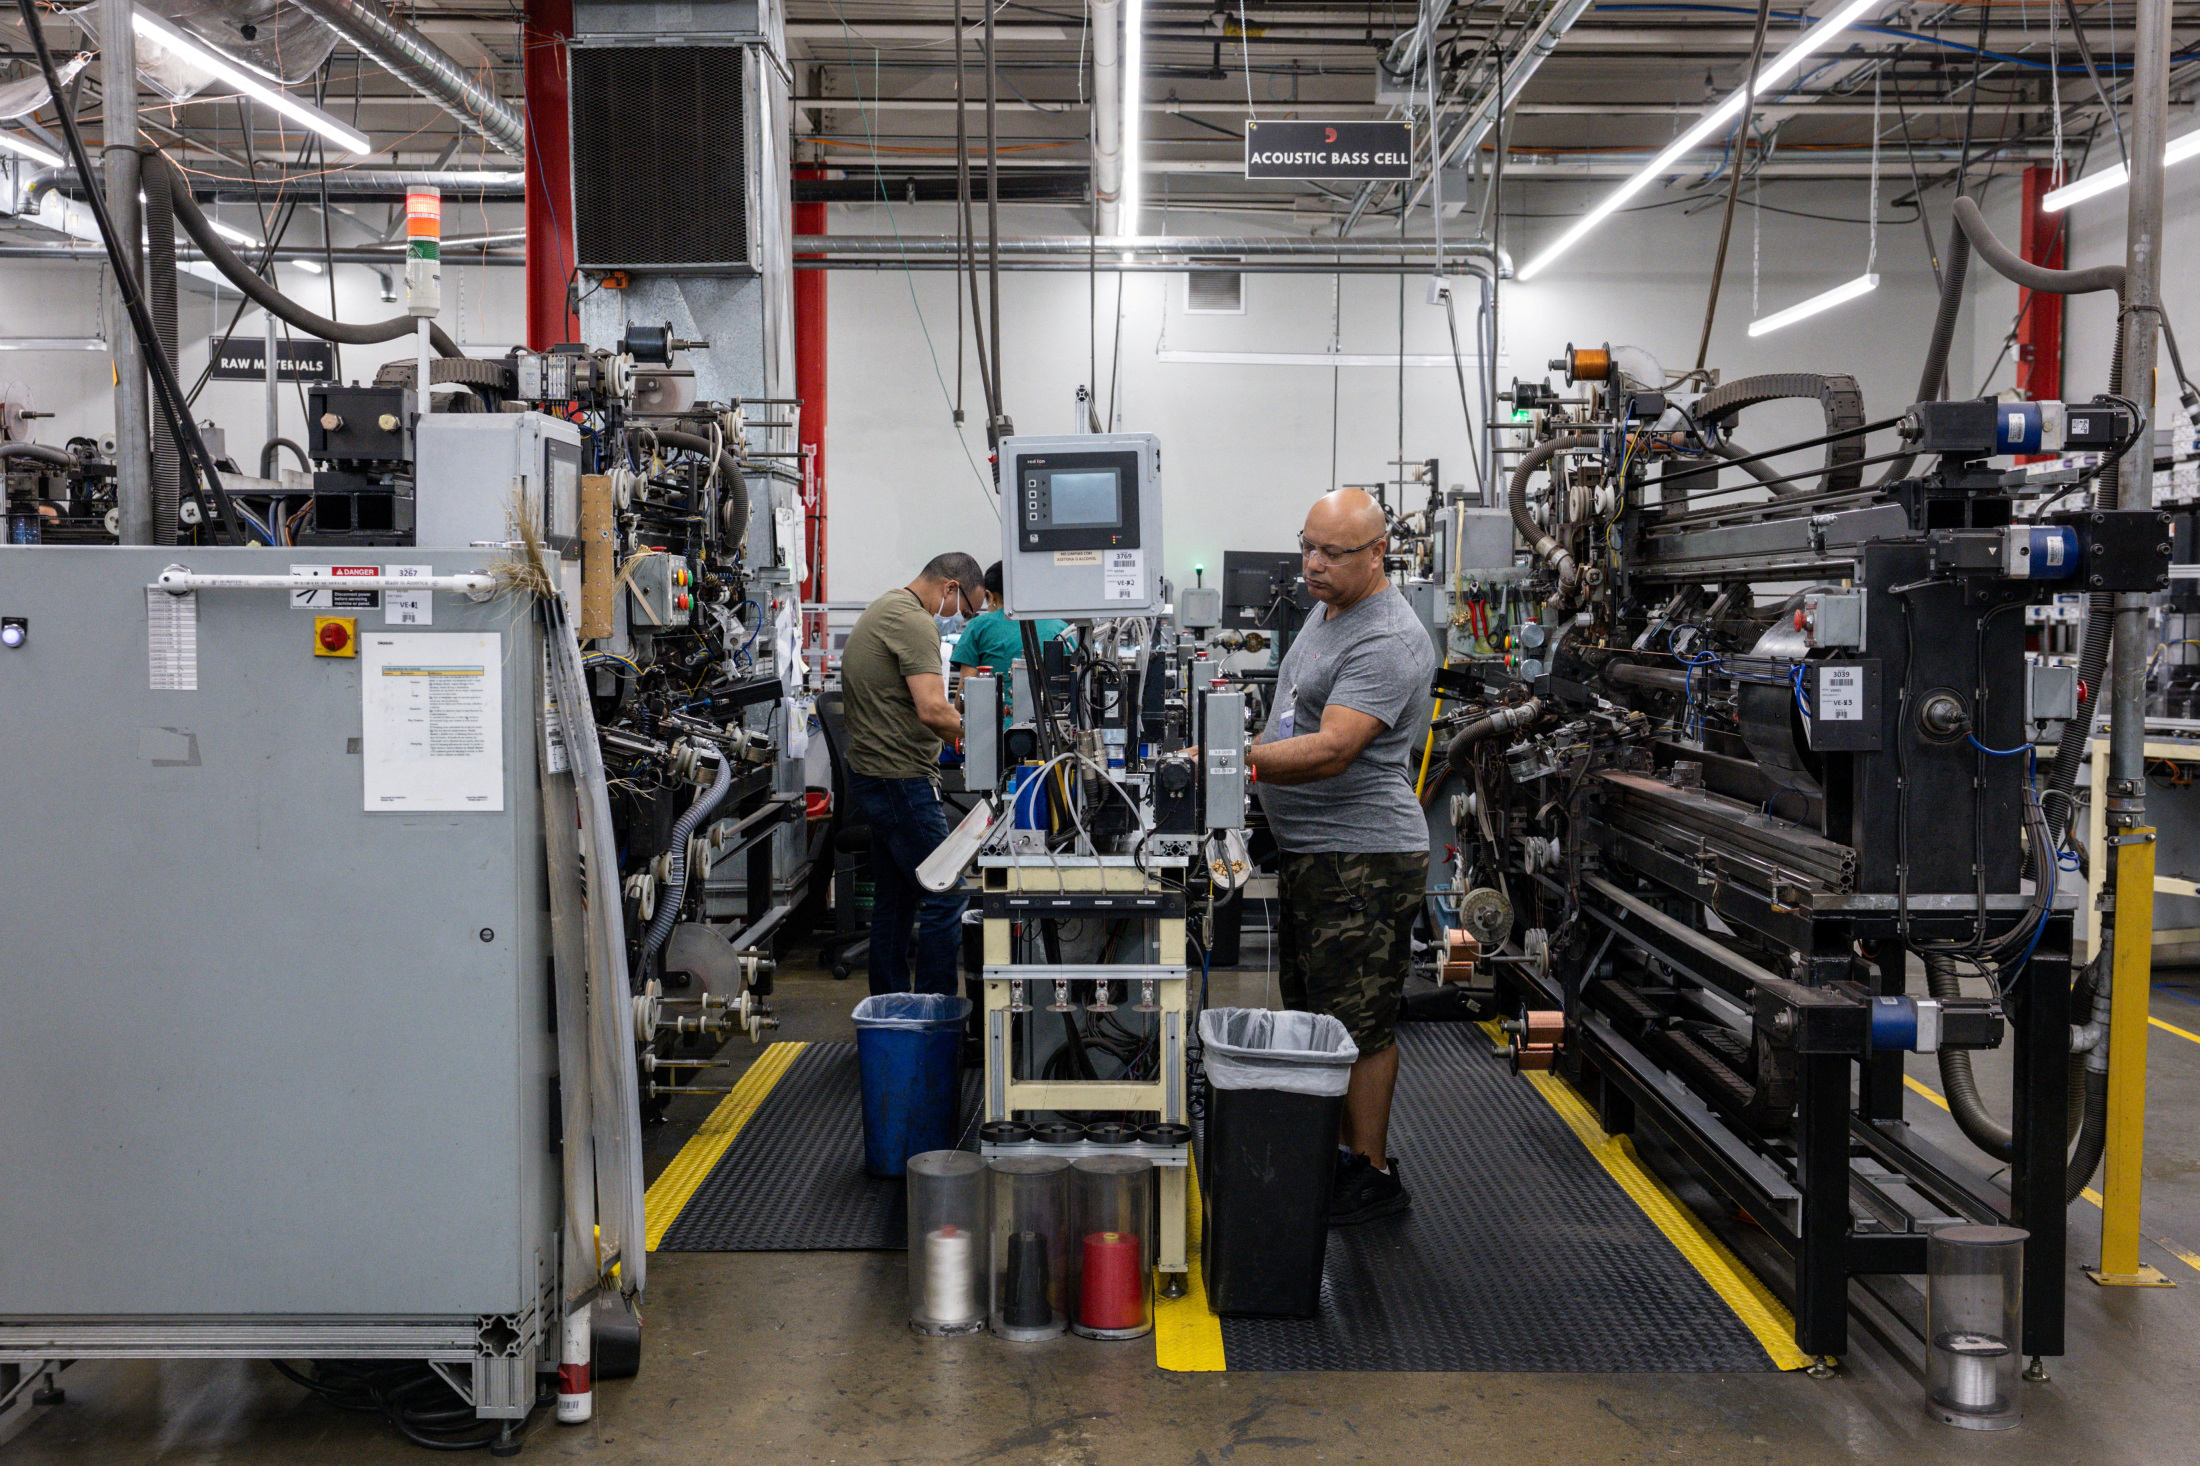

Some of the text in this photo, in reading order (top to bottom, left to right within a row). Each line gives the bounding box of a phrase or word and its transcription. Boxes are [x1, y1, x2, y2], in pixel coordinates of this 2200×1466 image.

[1251, 152, 1408, 164] ACOUSTIC BASS CELL
[221, 358, 323, 371] RAW MTERIALS
